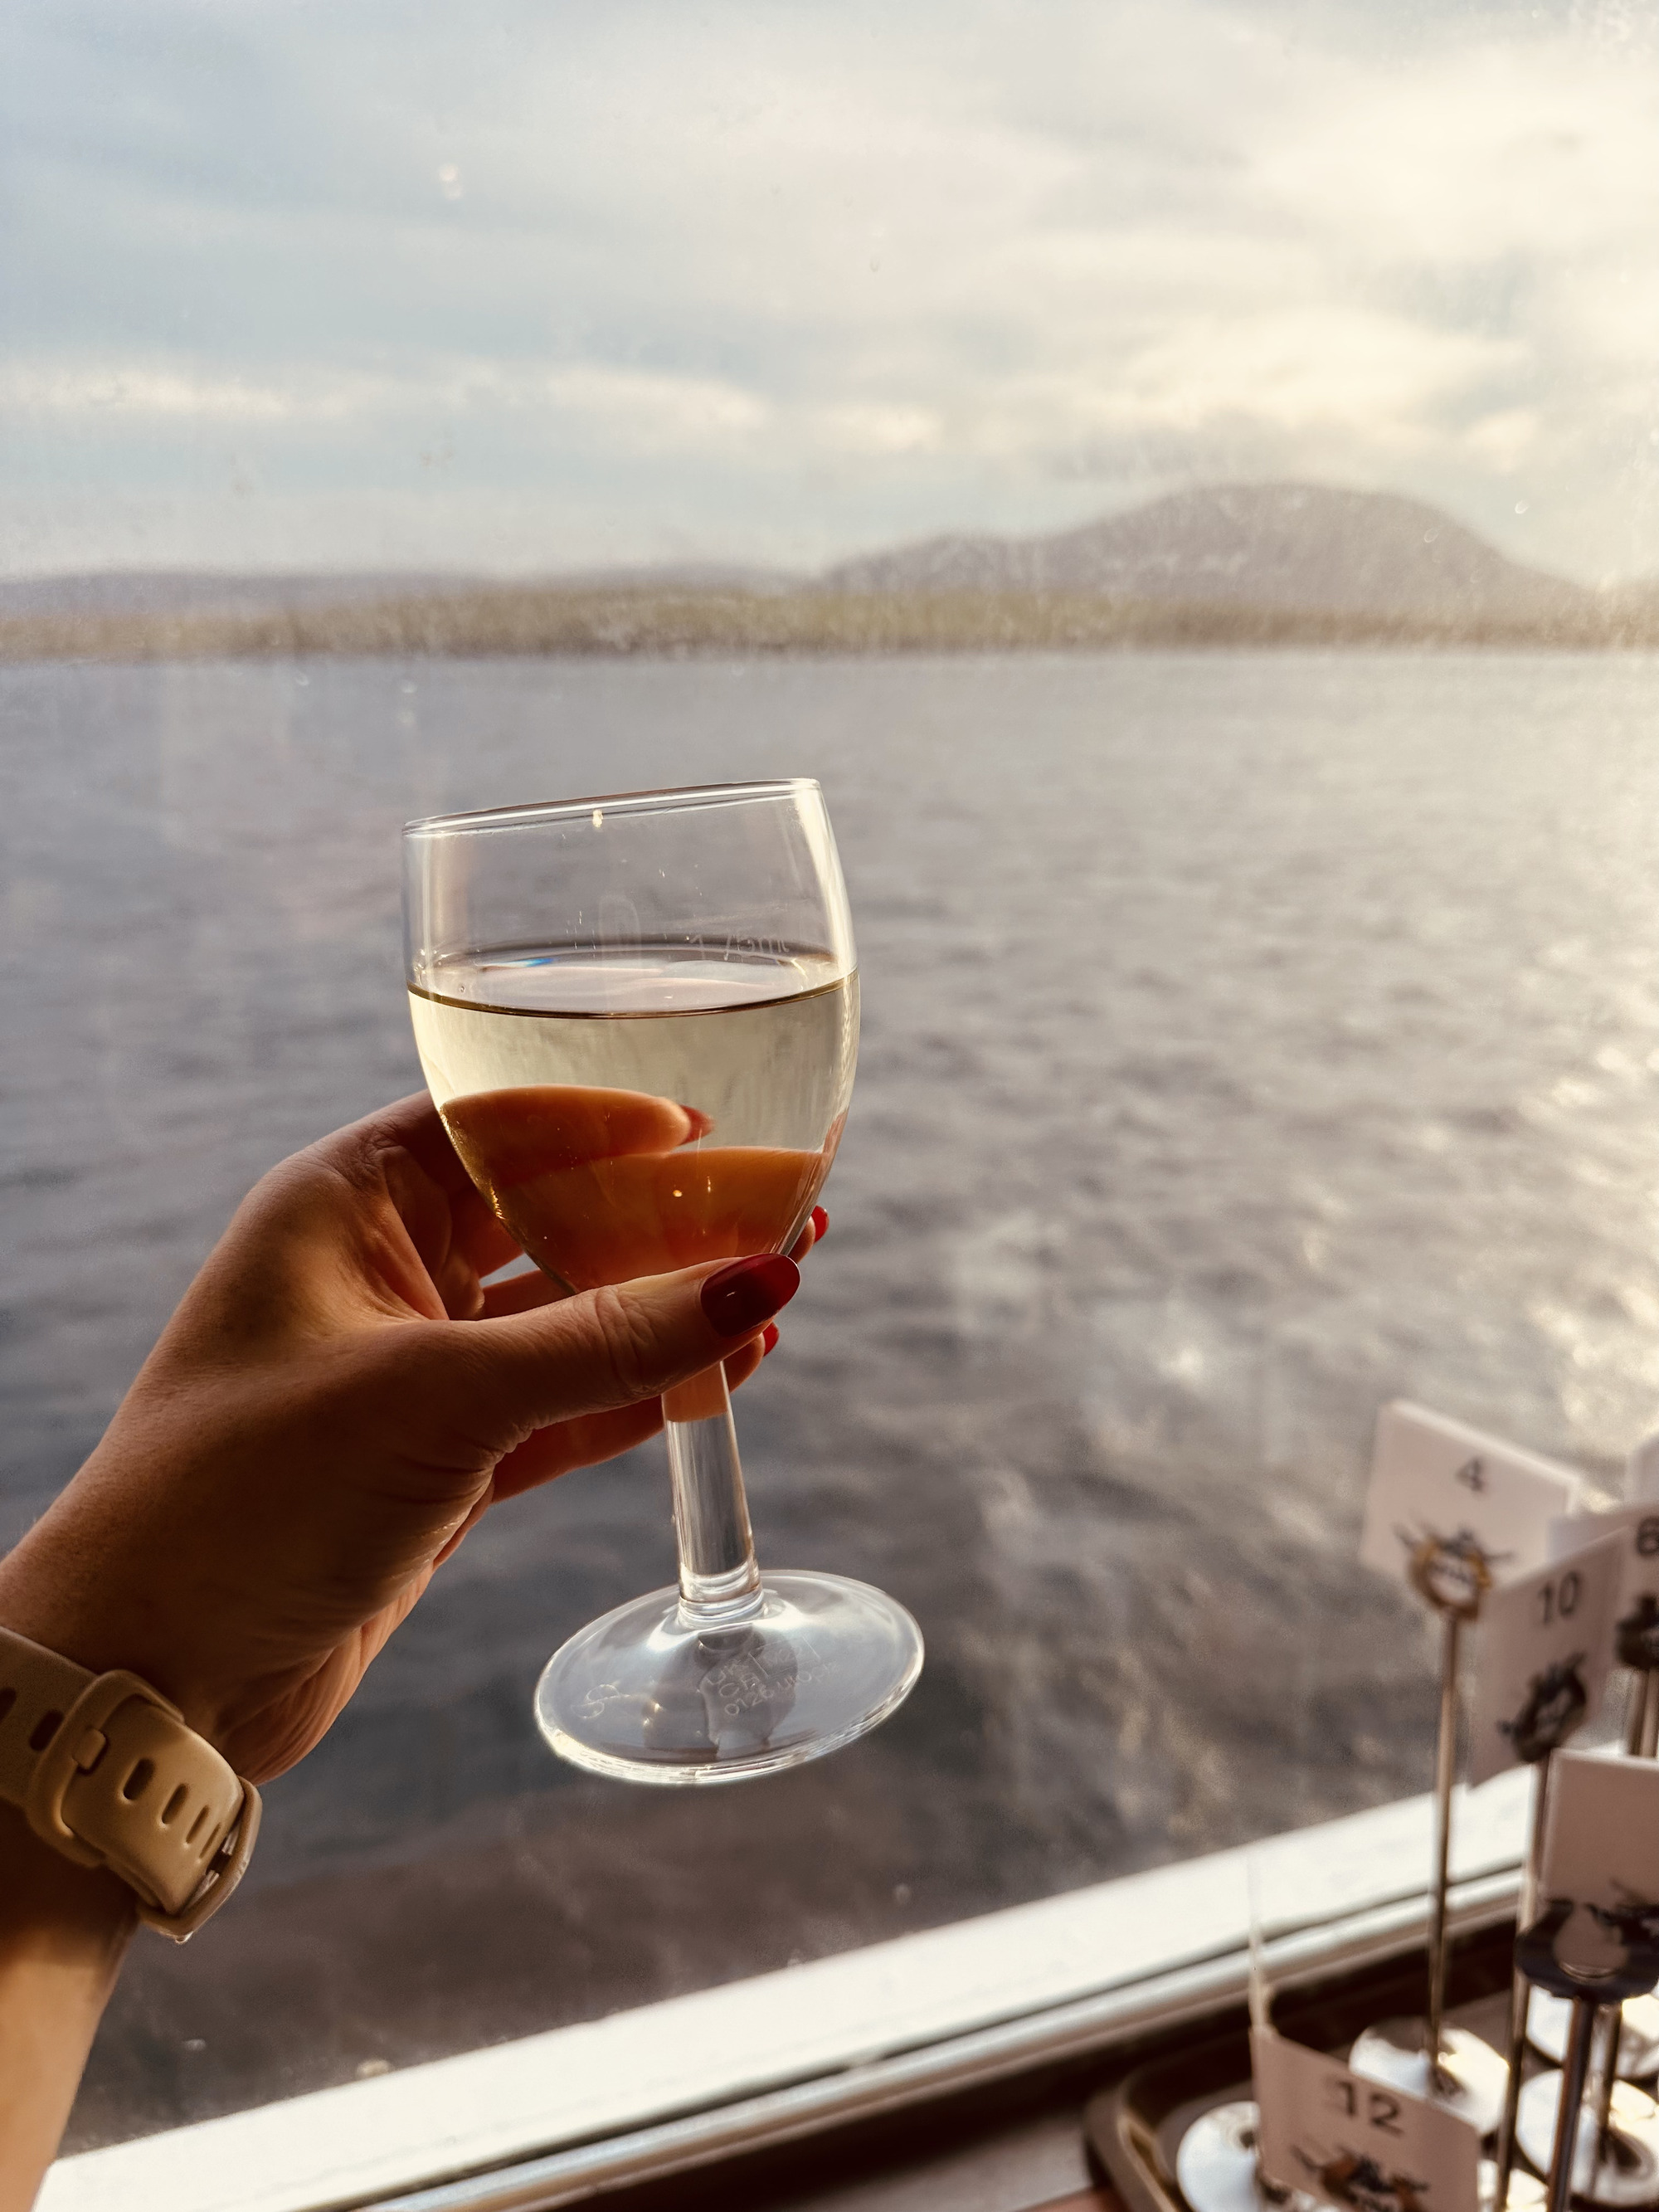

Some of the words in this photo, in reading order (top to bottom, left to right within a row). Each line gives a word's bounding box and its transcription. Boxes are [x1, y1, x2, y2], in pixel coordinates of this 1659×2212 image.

[1456, 1457, 1482, 1492] 4
[1537, 1571, 1580, 1625] 10
[1336, 2081, 1404, 2138] 12
